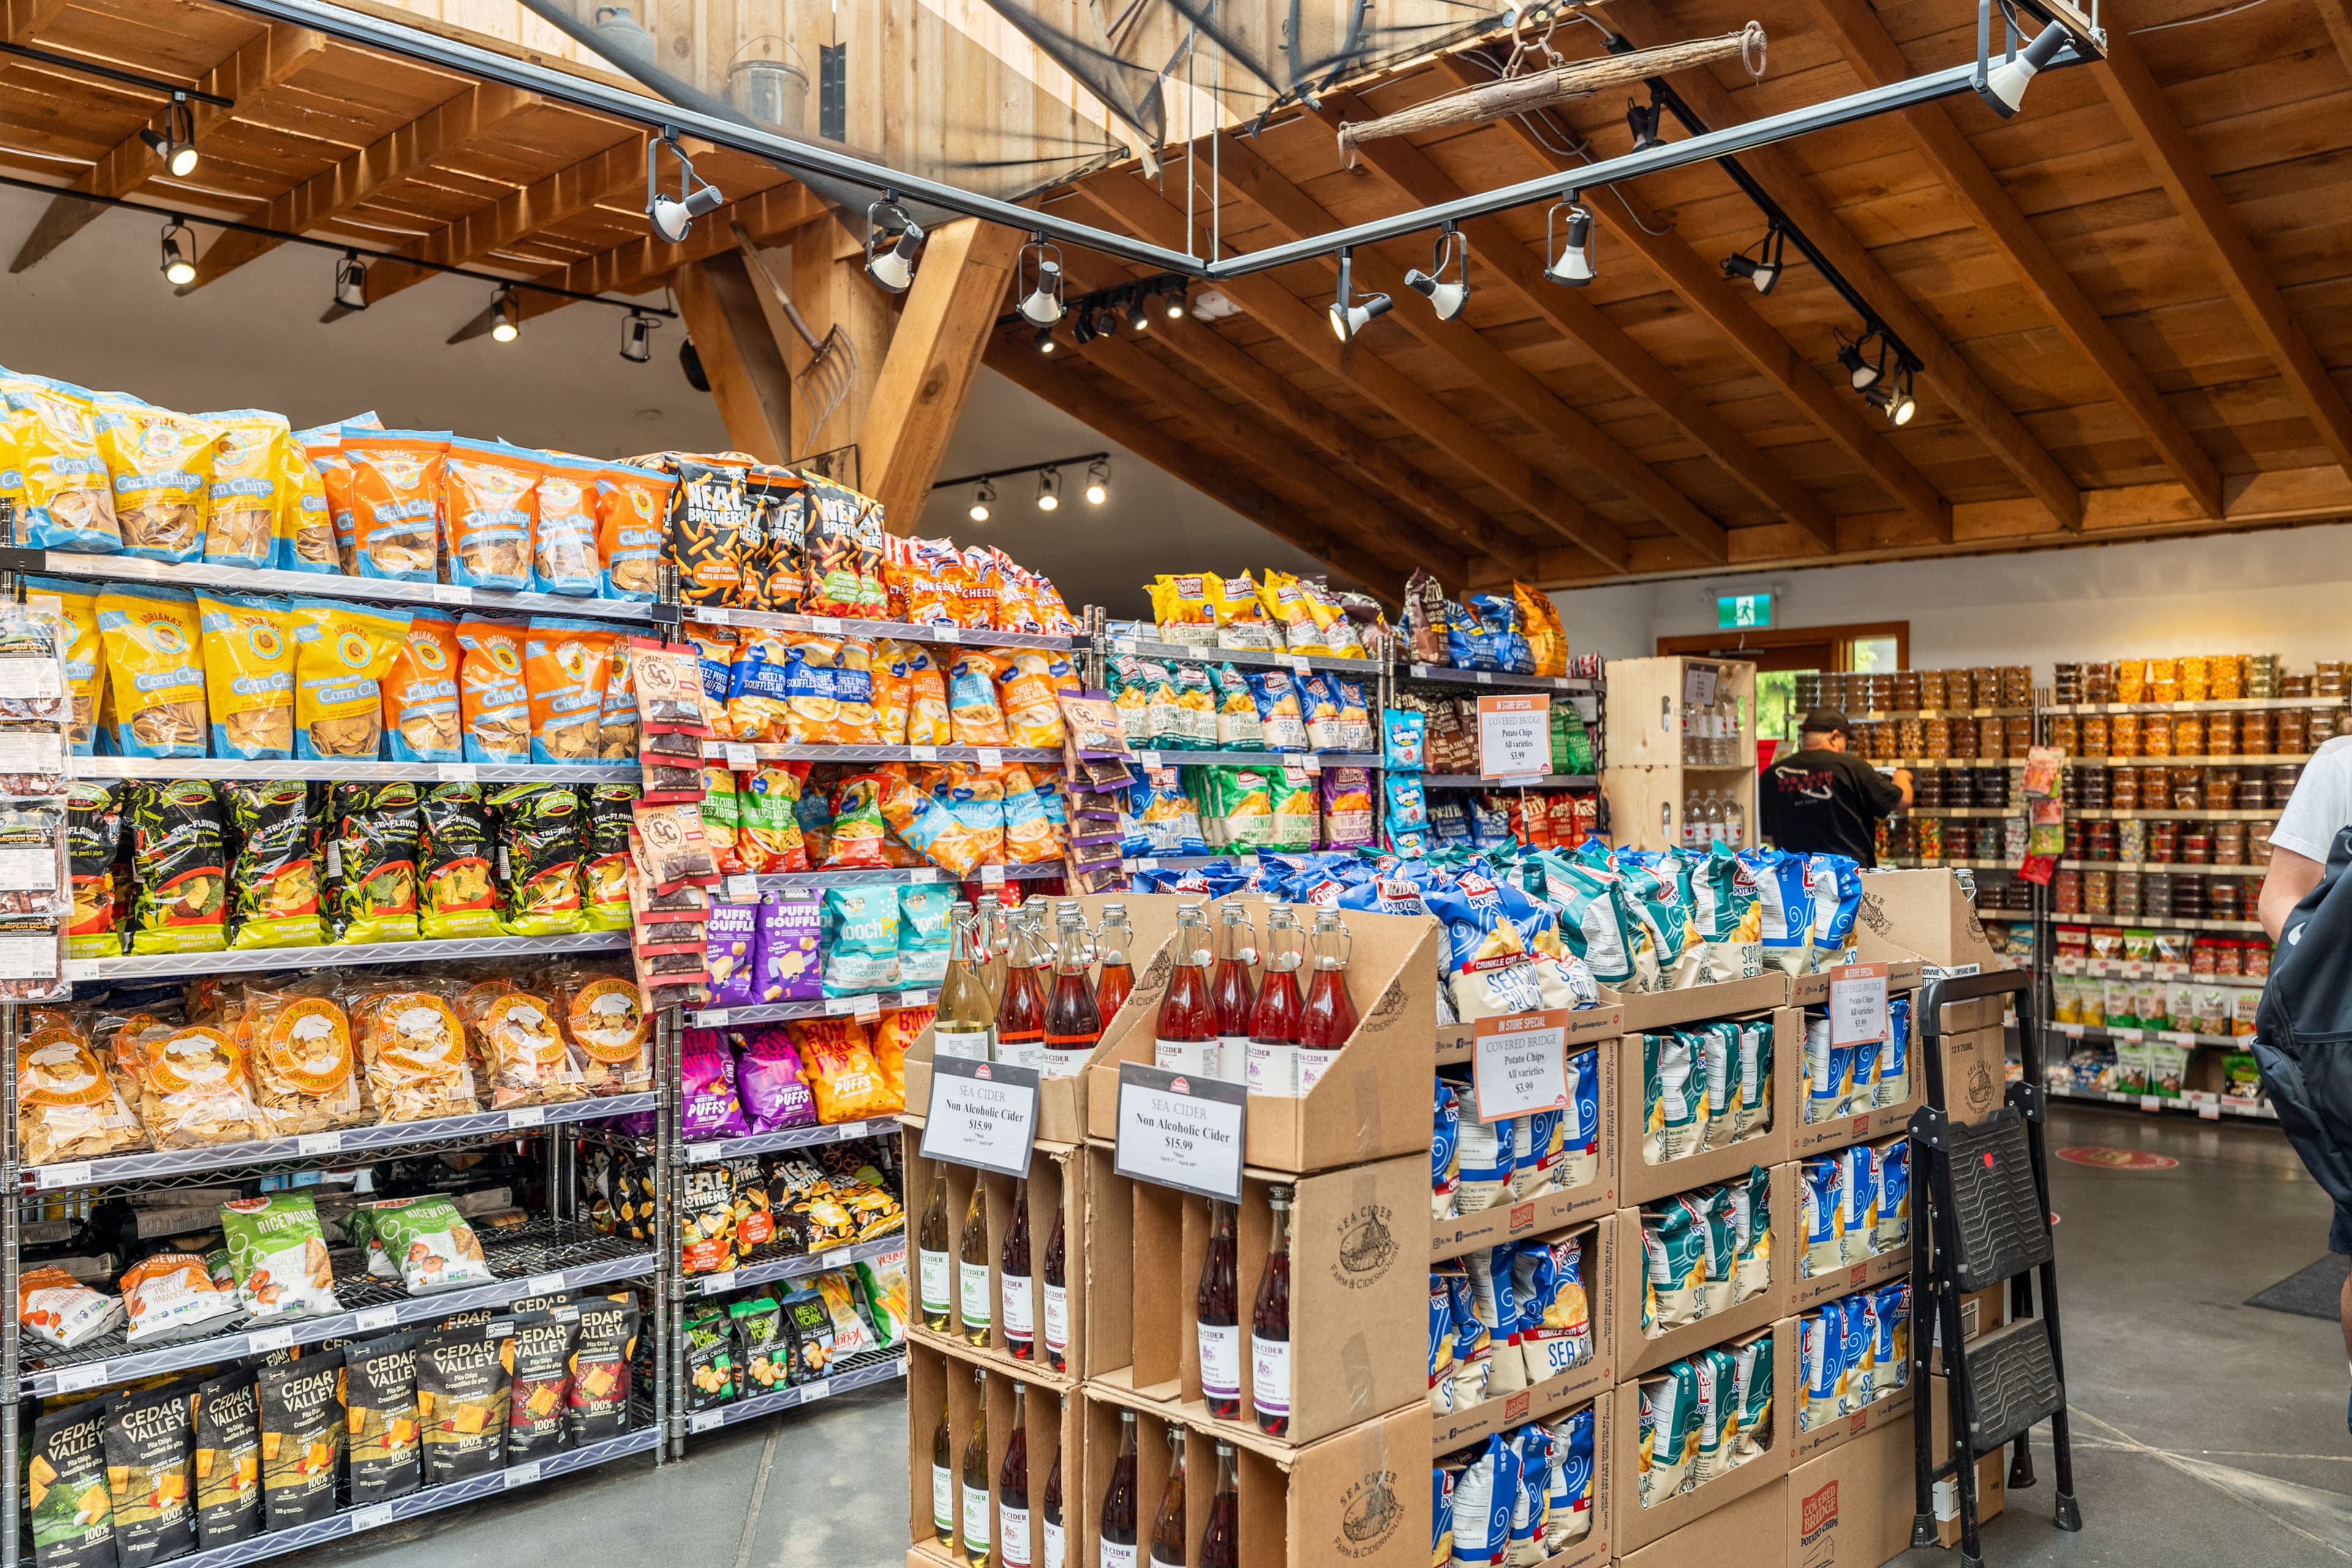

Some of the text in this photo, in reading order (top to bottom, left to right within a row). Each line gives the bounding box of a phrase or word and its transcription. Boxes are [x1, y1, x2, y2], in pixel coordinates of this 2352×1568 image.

[116, 472, 202, 489] Corn Chips
[466, 513, 500, 527] Chia
[913, 581, 962, 594] CHEEZES
[139, 612, 184, 628] ADRIANA'S
[406, 633, 441, 647] ADRIANA'S
[137, 674, 175, 690] Corn
[758, 671, 778, 682] CHEEZ
[1502, 701, 1515, 710] STORE
[1515, 700, 1532, 709] SPECIAL
[1489, 715, 1541, 726] COVERED BRIDGE
[1519, 729, 1532, 737] Chips
[540, 801, 558, 813] FRESH
[171, 820, 221, 836] TRI-FLAVOUR
[437, 818, 481, 831] TRI-FLAVOUR
[1148, 823, 1167, 834] SEA
[447, 918, 477, 927] TORTILLA
[767, 943, 791, 952] Cheddar
[838, 960, 892, 971] KINDA SWEET
[1475, 957, 1504, 969] CRINKLE
[843, 967, 882, 976] SAVOURY
[1487, 968, 1523, 994] SEA
[1838, 982, 1882, 994] COVERED BRIDGE
[1863, 996, 1874, 1005] Chips
[568, 1014, 589, 1024] Natural
[1366, 995, 1409, 1033] CIDERHOUSE
[1499, 1016, 1545, 1031] IN STORE SPECIAL
[1855, 1019, 1867, 1028] $3.99
[1486, 1034, 1557, 1052] COVERED BRIDGE
[1961, 1043, 1973, 1052] 750ML
[1504, 1052, 1544, 1065] Potato Chips
[1507, 1067, 1544, 1080] All varieties
[834, 1075, 872, 1095] PUFFS
[1515, 1082, 1533, 1094] $3.99
[959, 1085, 1005, 1102] SEA CIDER
[687, 1100, 726, 1117] PUFFS
[946, 1099, 1023, 1122] Non Alcoholic Cider
[1152, 1098, 1207, 1120] SEA CIDER
[969, 1118, 992, 1131] $15.99
[1136, 1113, 1230, 1143] Non Alcoholic Cider
[1166, 1136, 1193, 1151] $15.99
[257, 1209, 317, 1234] RICEWORK
[1337, 1205, 1392, 1235] SEA CIDER
[924, 1255, 943, 1264] CIDER
[1330, 1243, 1400, 1289] FARM & CIDERHOUSE
[1005, 1280, 1023, 1289] CIDER
[794, 1303, 818, 1318] NEW
[747, 1318, 773, 1329] NEW
[797, 1312, 823, 1327] YORK
[750, 1329, 777, 1342] YORK
[1537, 1325, 1576, 1339] CRINKLE CUT
[433, 1341, 495, 1362] CEDAR
[514, 1337, 567, 1358] VALLEY
[747, 1343, 785, 1355] BAGEL CRISPS
[1261, 1346, 1283, 1355] CIDER
[1549, 1343, 1574, 1366] SEA
[435, 1352, 494, 1374] VALLEY
[466, 1372, 478, 1381] Chips
[281, 1370, 334, 1399] CEDAR
[445, 1380, 470, 1389] Croustilles
[284, 1382, 333, 1412] VALLEY
[122, 1398, 184, 1427] CEDAR
[50, 1416, 106, 1447] CEDAR
[125, 1411, 185, 1444] VALLEY
[533, 1419, 556, 1431] 100%
[48, 1430, 104, 1461] VALLEY
[459, 1434, 482, 1449] 100%
[307, 1472, 328, 1490] 100%
[1804, 1485, 1836, 1517] COVERED
[161, 1505, 183, 1523] 100%
[1007, 1513, 1027, 1521] CIDER
[1804, 1497, 1836, 1531] BRIDGE
[84, 1523, 110, 1542] 100%
[1801, 1518, 1838, 1547] POTATO CHIPS
[1109, 1550, 1131, 1558] CIDER
